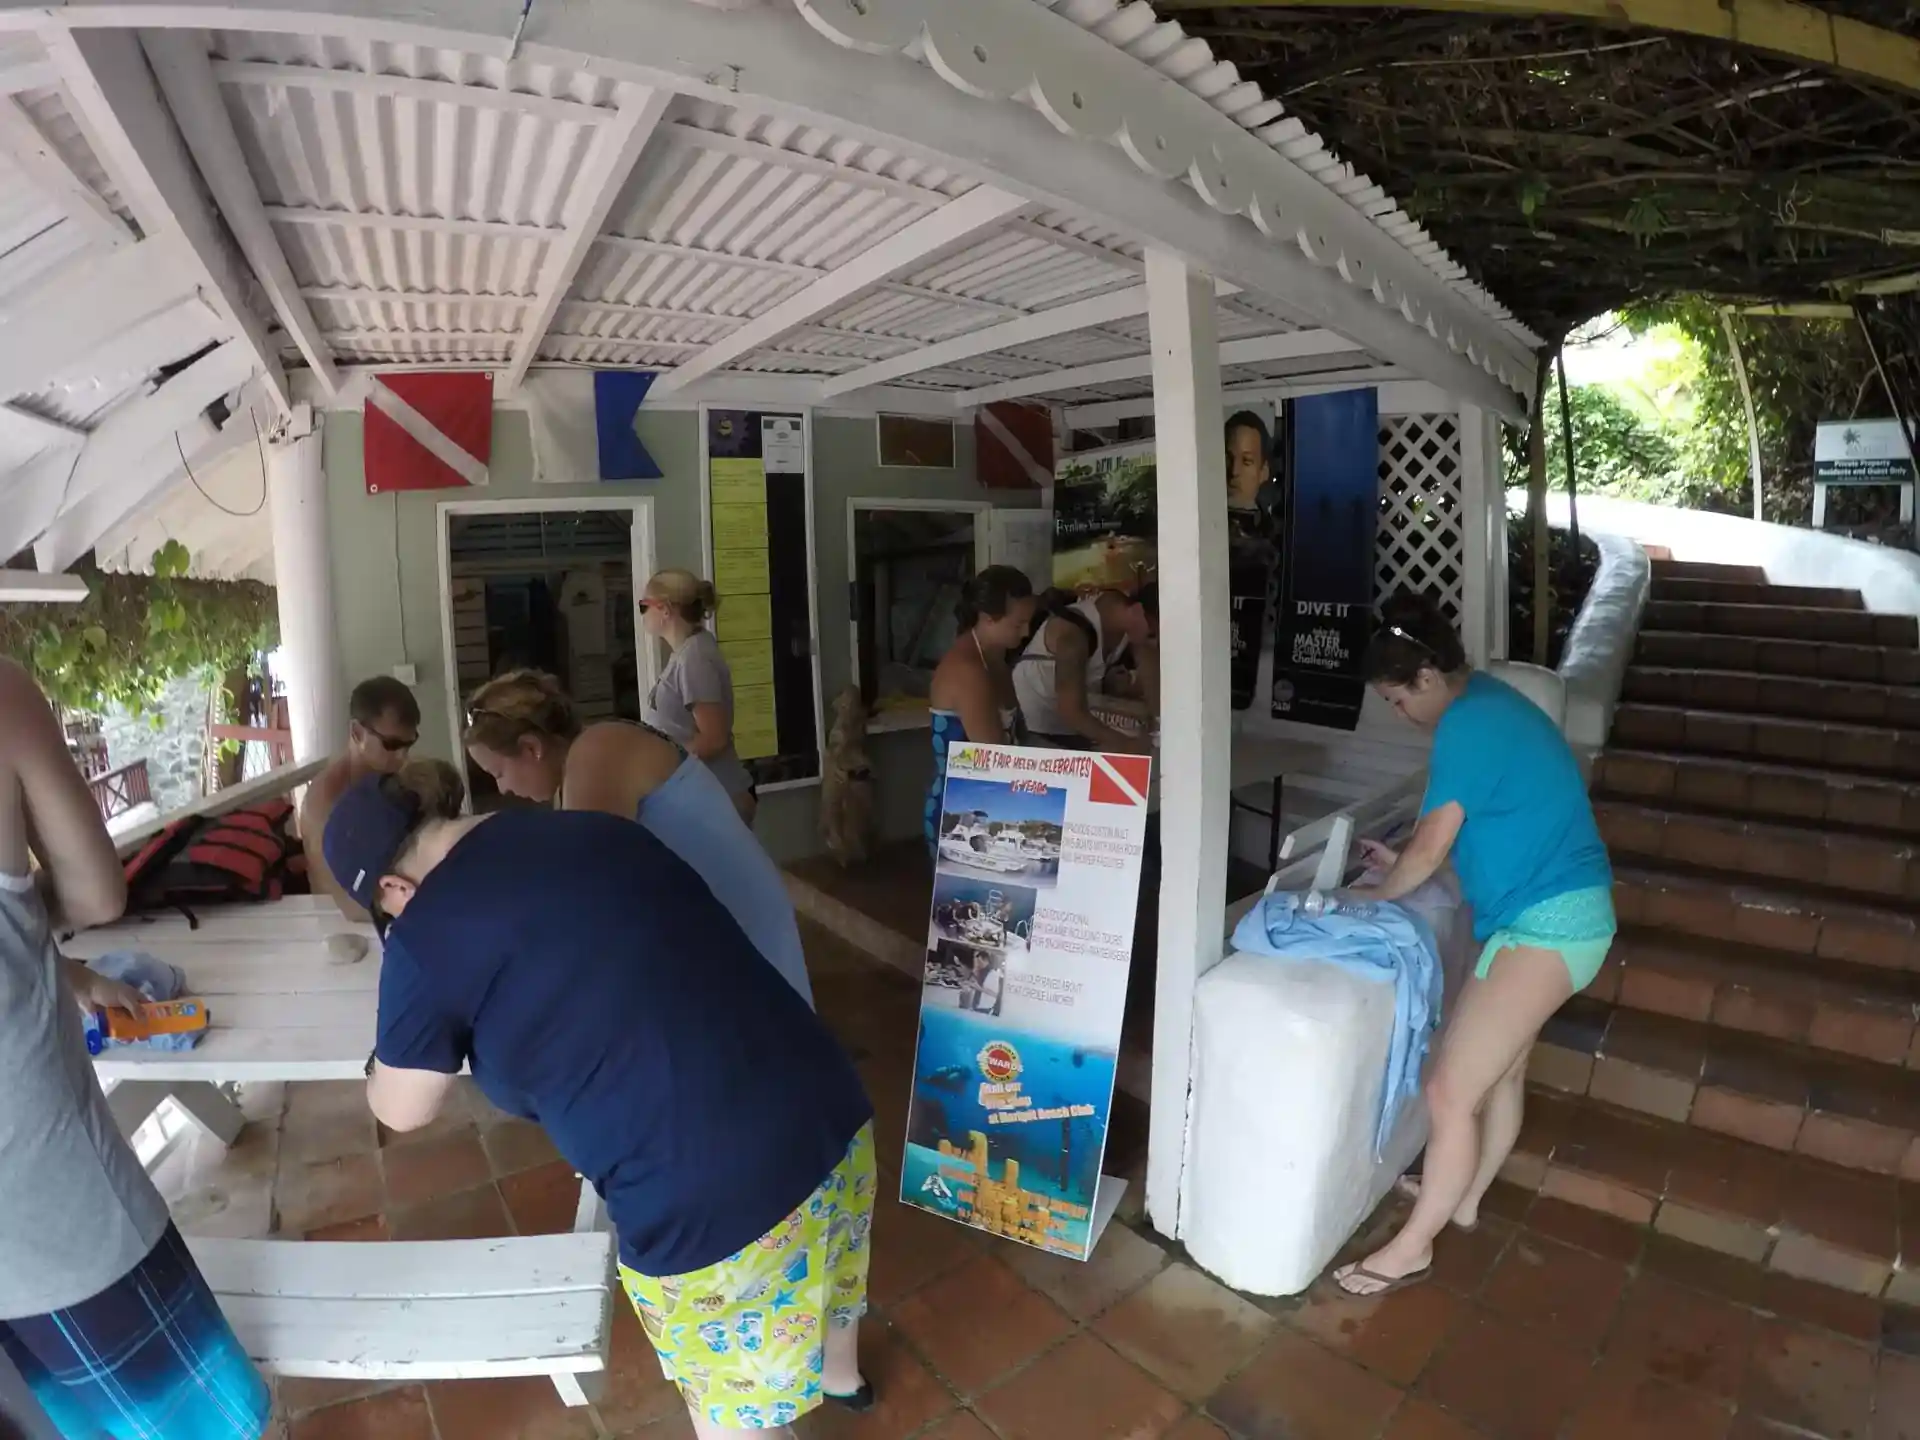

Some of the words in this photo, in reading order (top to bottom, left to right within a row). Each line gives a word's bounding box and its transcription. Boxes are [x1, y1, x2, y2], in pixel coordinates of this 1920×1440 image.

[1296, 601, 1332, 617] DIVE
[1336, 603, 1350, 618] IT
[1294, 633, 1340, 648] MASTER
[1324, 645, 1350, 660] DIVER
[1292, 653, 1341, 669] Challenge
[973, 747, 990, 770] DIVE
[992, 751, 1012, 769] FAIR
[1013, 756, 1037, 772] HELEN
[1039, 757, 1092, 778] CELEBRATES
